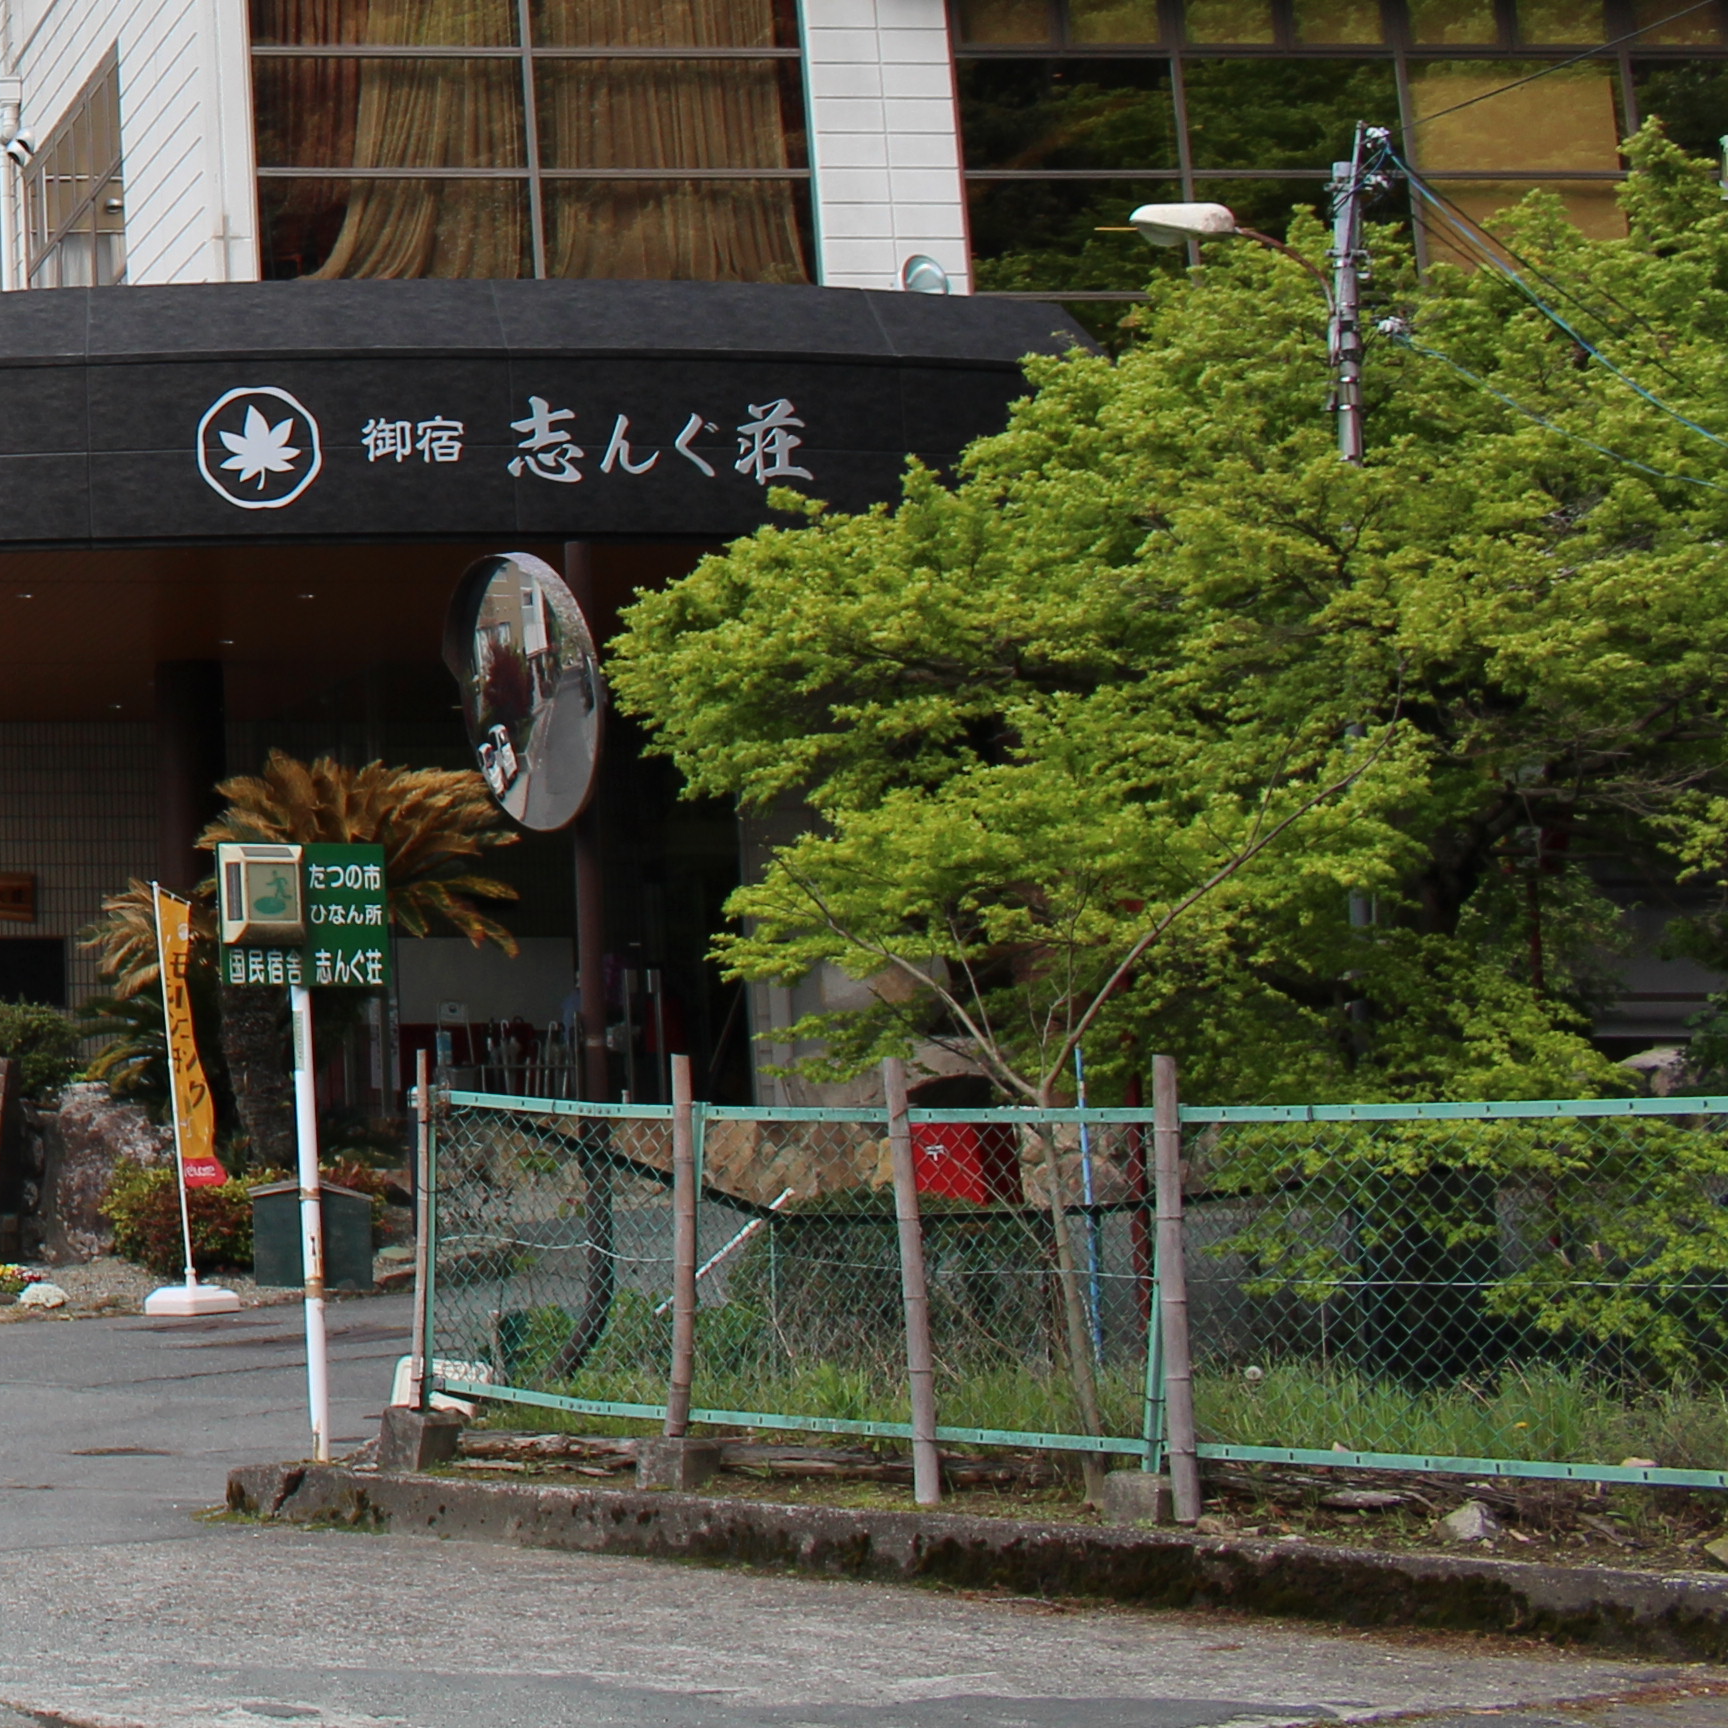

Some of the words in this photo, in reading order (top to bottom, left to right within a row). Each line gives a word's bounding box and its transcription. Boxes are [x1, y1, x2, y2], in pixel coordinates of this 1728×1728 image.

[360, 415, 465, 463] 御宿
[507, 395, 814, 485] 志んぐ荘
[308, 863, 381, 891] たつの市
[310, 903, 383, 926] ひなん所
[229, 948, 302, 984] 国民宿舎
[315, 948, 383, 984] 志んぐ荘
